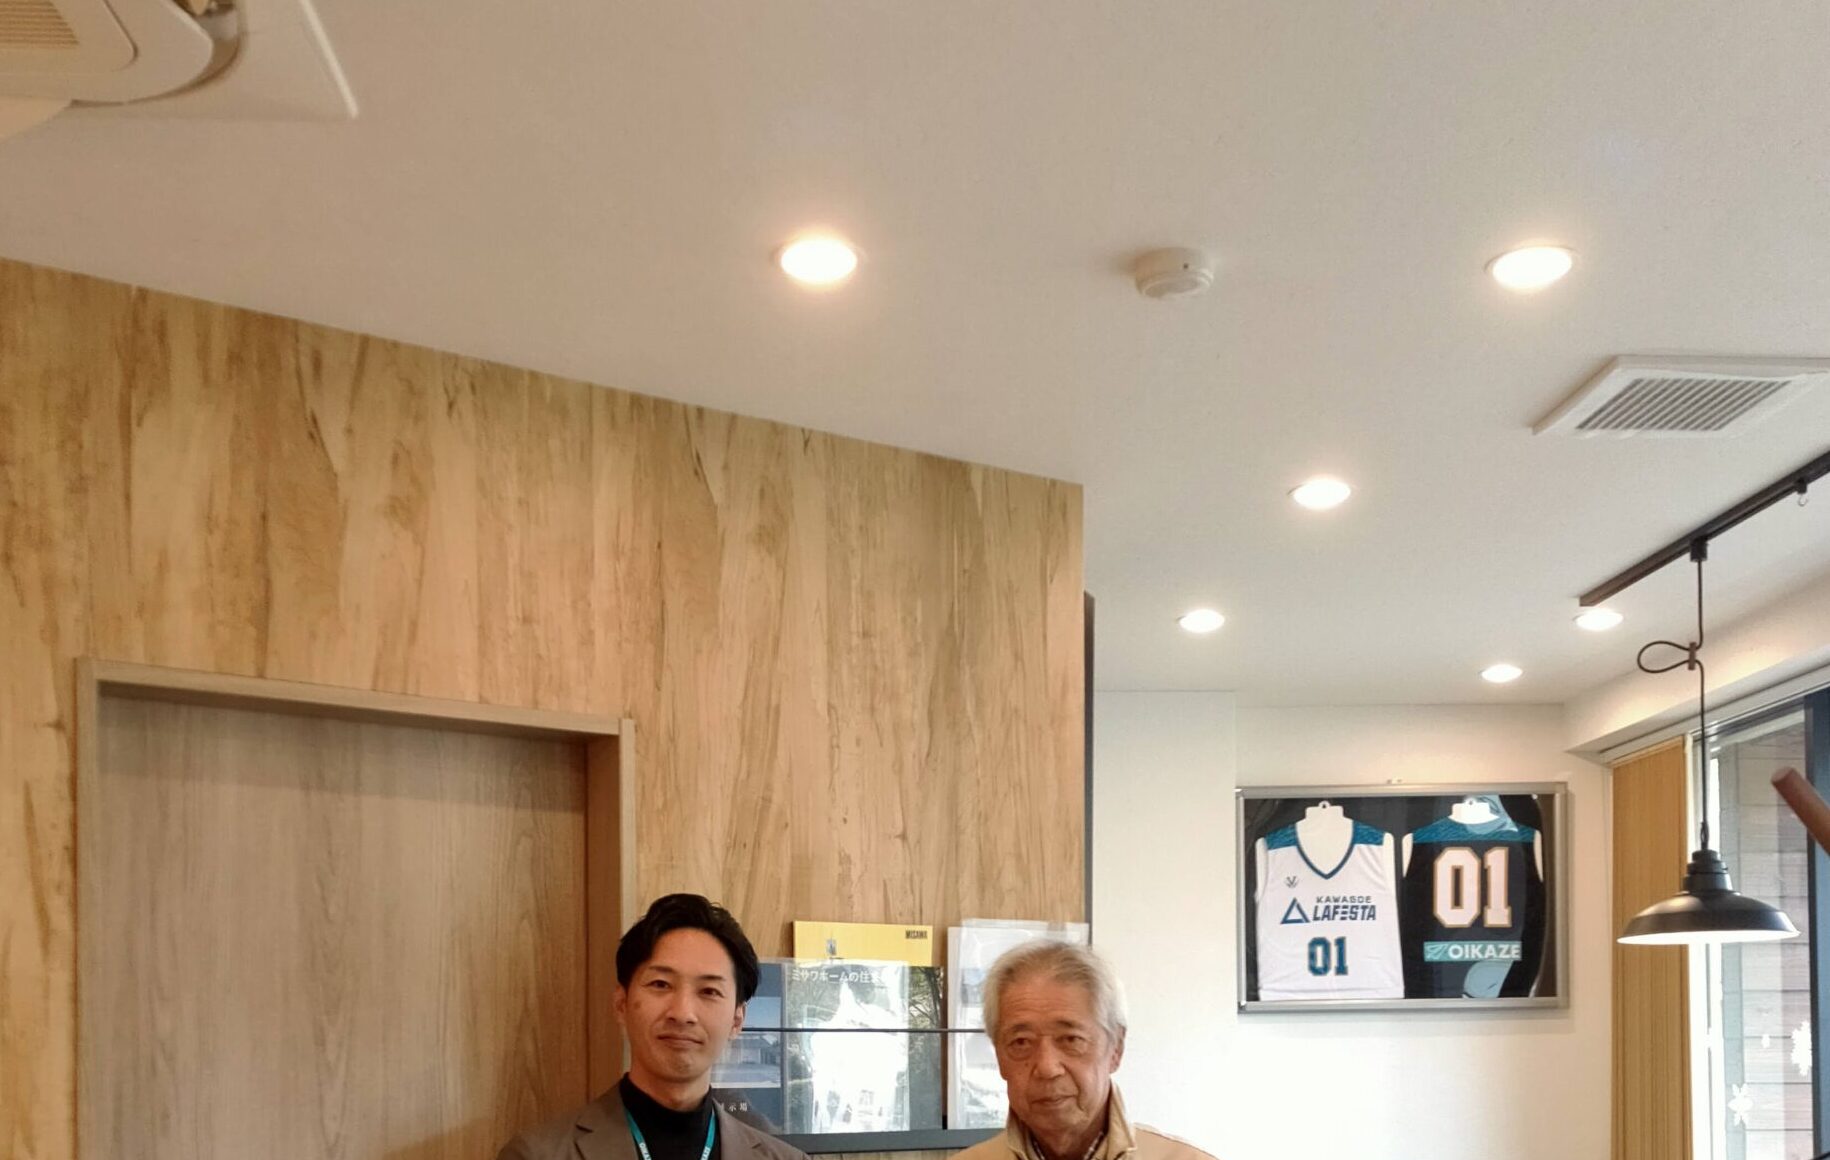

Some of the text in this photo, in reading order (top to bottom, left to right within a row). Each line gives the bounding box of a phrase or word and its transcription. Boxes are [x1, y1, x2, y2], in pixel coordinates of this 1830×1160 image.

[1433, 846, 1512, 928] 01
[1312, 905, 1377, 921] LAFESTA
[1307, 935, 1349, 976] 01
[1448, 943, 1521, 960] OIKAZE
